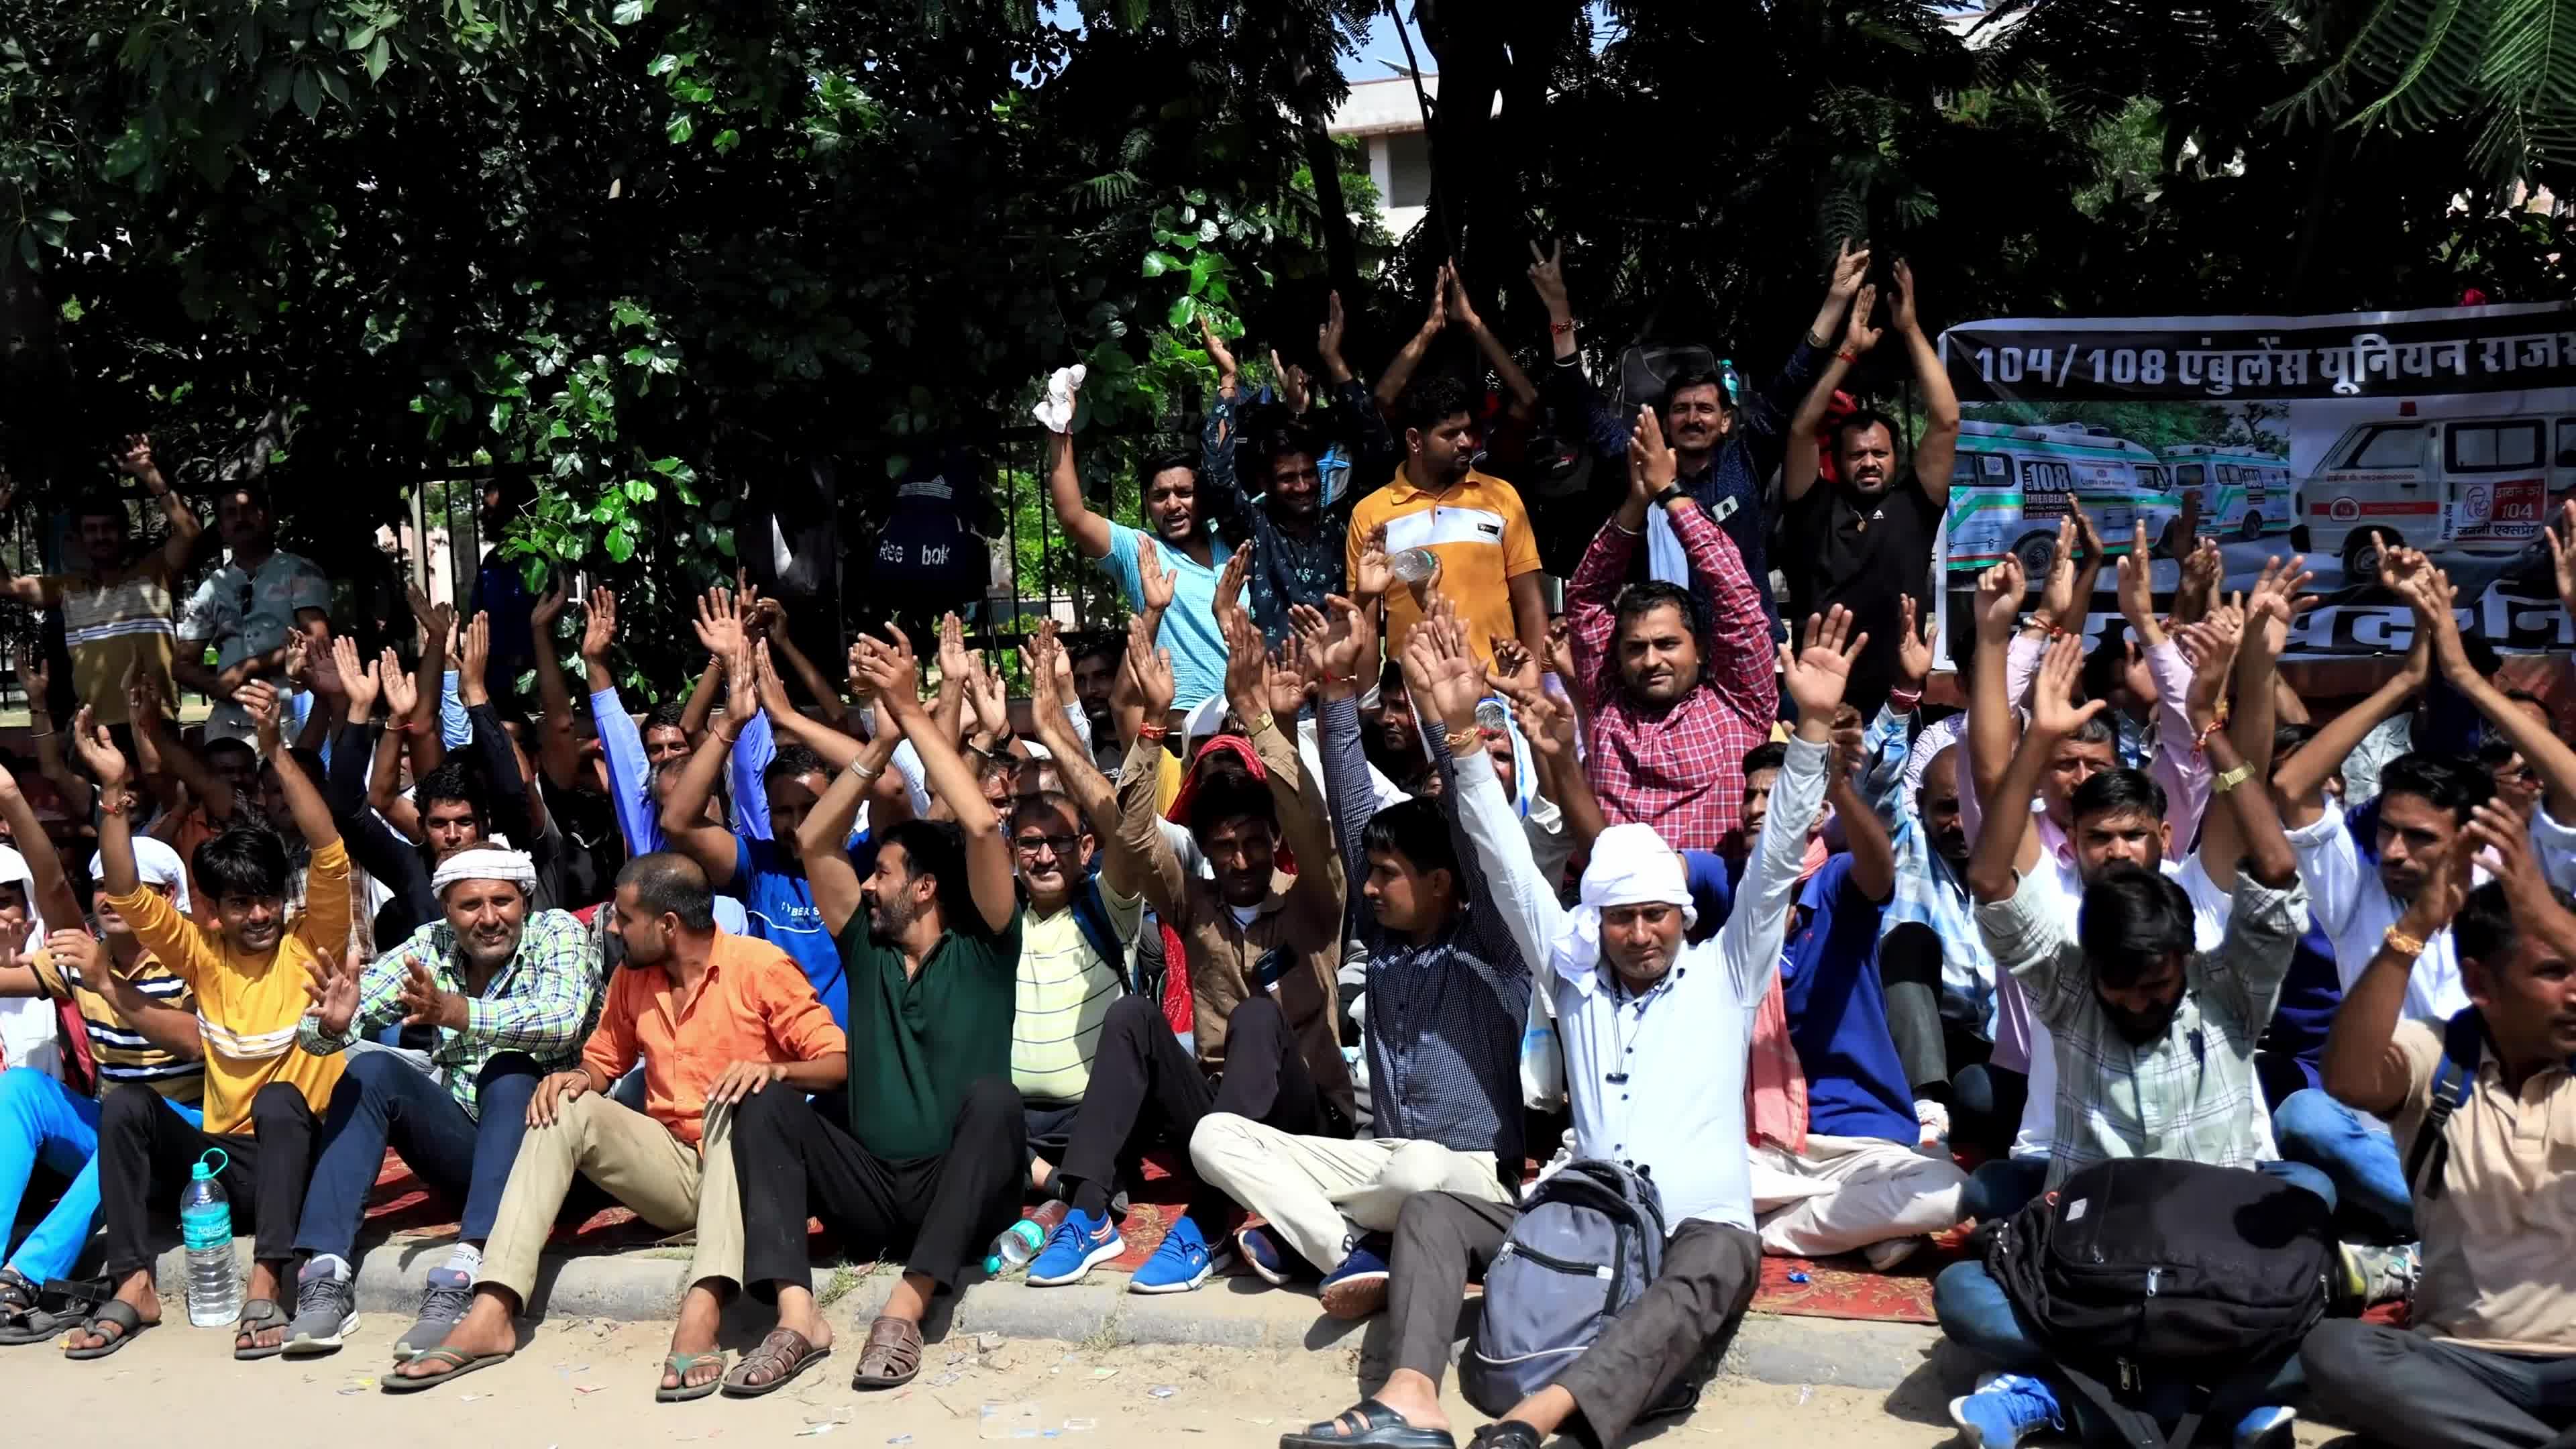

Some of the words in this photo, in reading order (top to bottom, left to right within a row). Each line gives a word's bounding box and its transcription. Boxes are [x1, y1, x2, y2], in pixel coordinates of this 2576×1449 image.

[2176, 337, 2312, 395] एंबुलेंस
[2316, 333, 2470, 394] यूनियन
[2027, 463, 2070, 492] 108
[2501, 503, 2534, 519] 104
[879, 539, 904, 564] Ree
[921, 543, 951, 566] bok
[781, 901, 810, 917] CYBER
